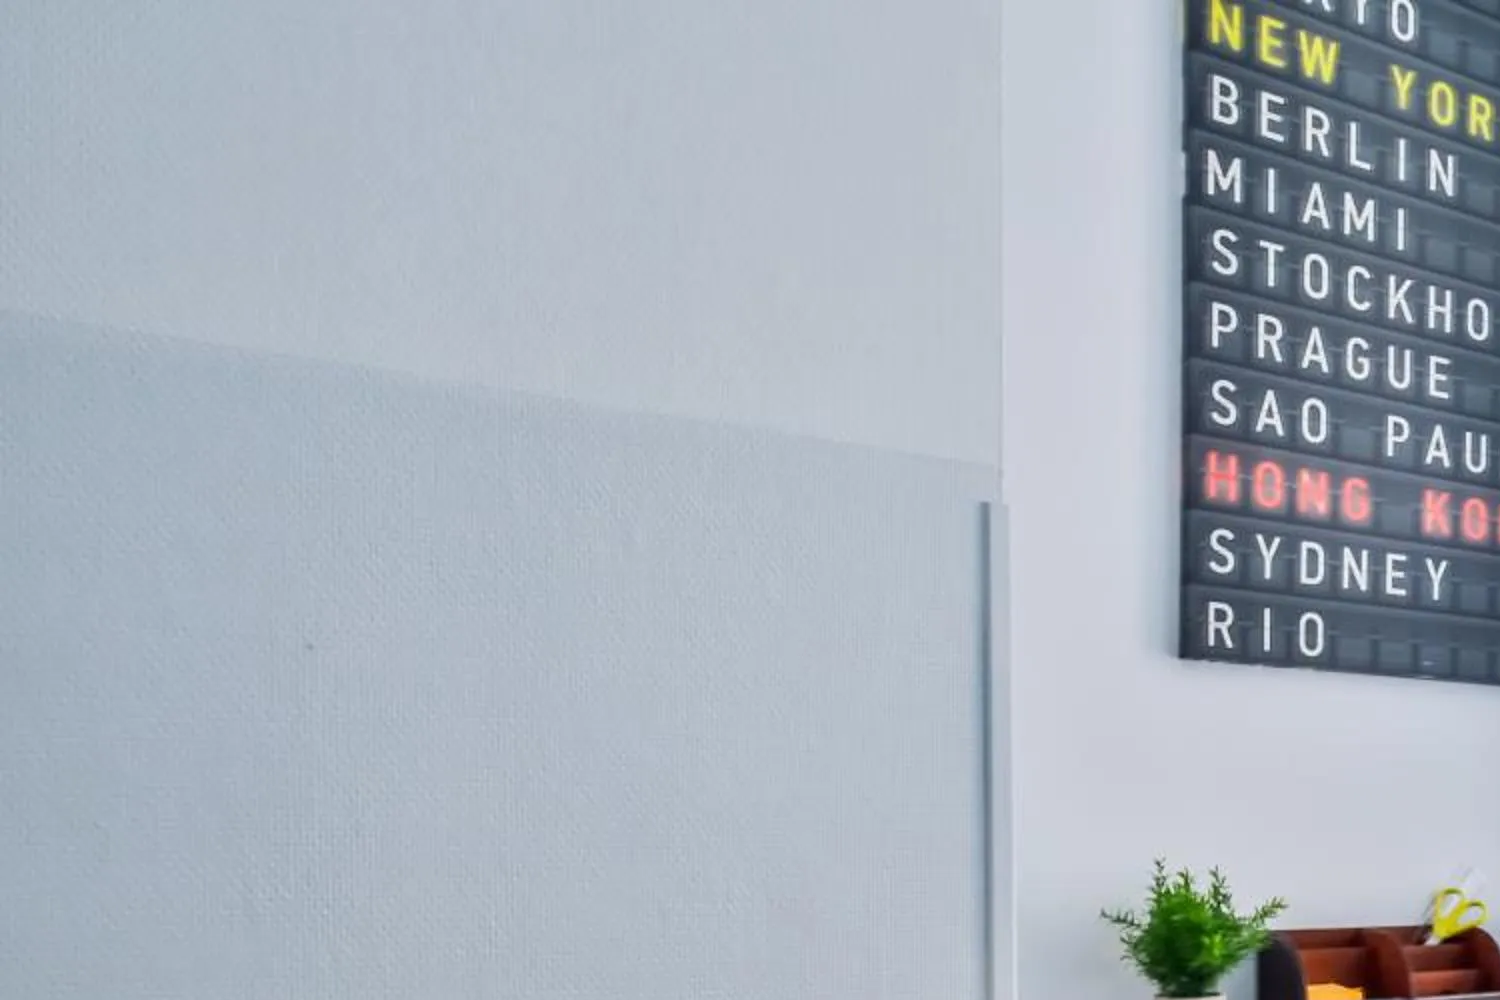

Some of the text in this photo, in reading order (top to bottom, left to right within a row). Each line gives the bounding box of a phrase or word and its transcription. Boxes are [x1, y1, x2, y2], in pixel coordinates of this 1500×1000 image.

[1210, 0, 1340, 84] NEW
[1304, 0, 1415, 42] YO
[1212, 74, 1455, 197] BERLIN
[1207, 150, 1407, 251] MIAMI
[1212, 304, 1452, 399] PRAGUE
[1211, 380, 1328, 443] SAO
[1205, 450, 1371, 523] HONG
[1208, 529, 1449, 600] SYDNEY
[1207, 602, 1325, 657] RIO
